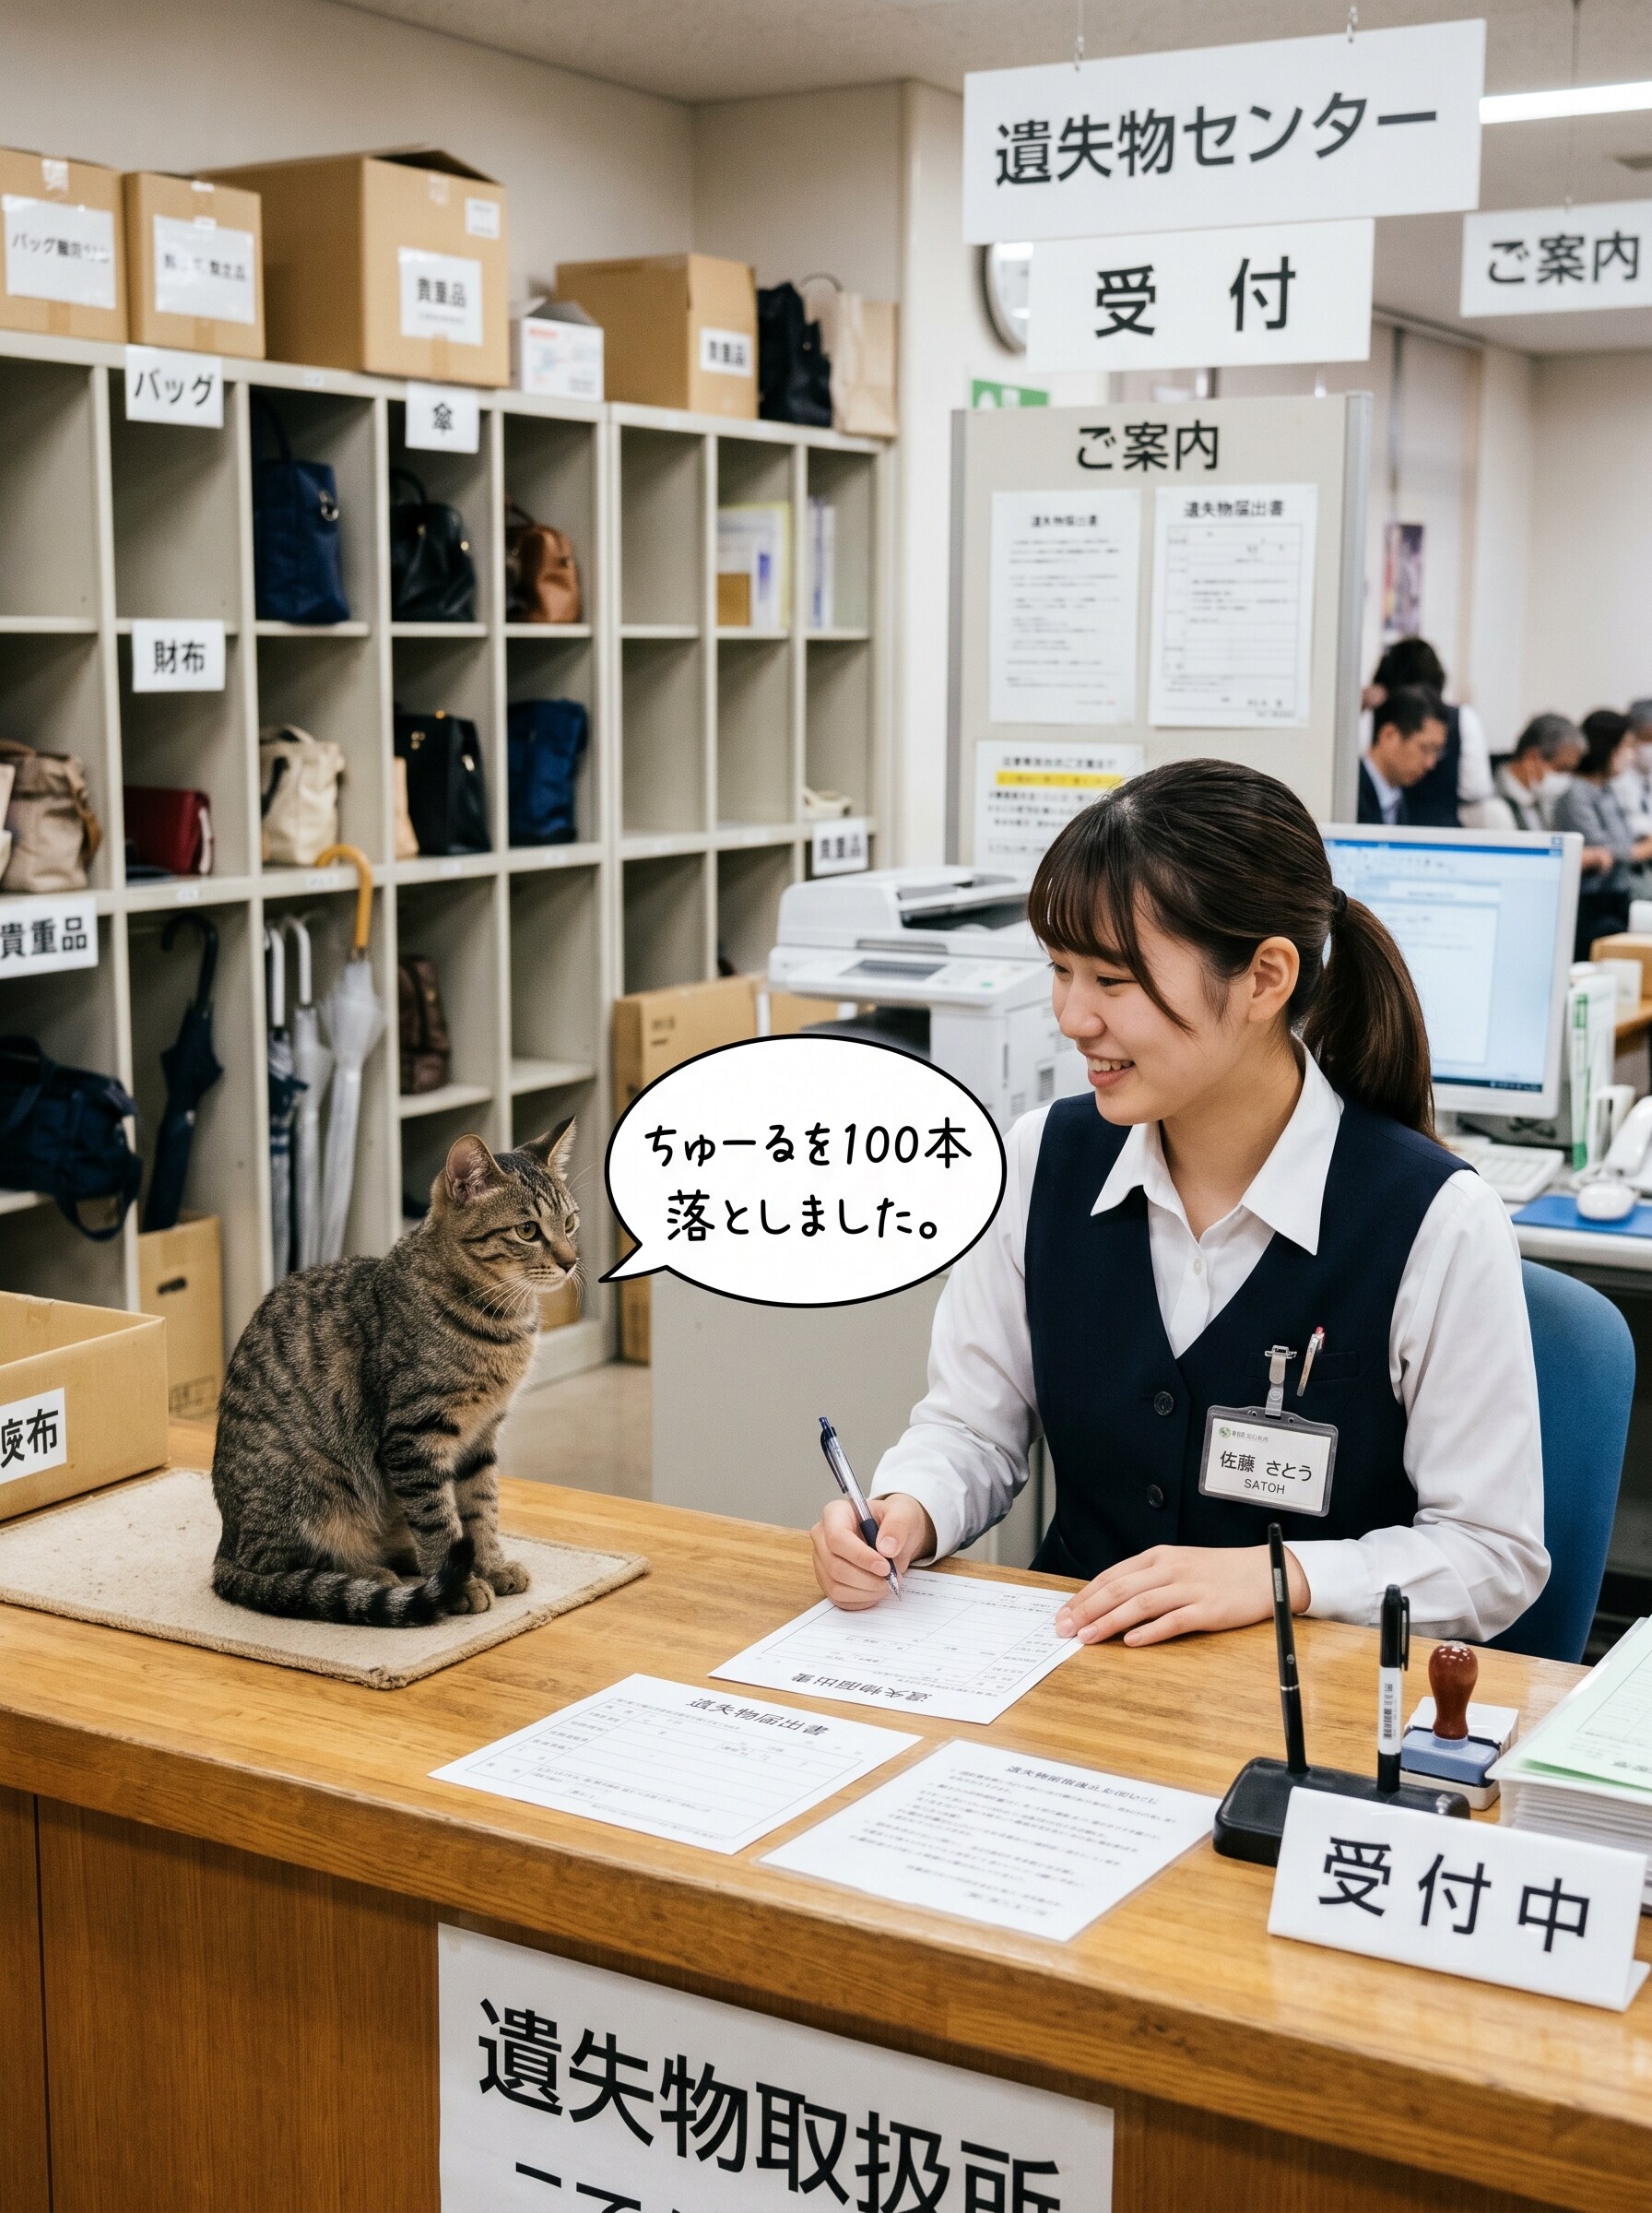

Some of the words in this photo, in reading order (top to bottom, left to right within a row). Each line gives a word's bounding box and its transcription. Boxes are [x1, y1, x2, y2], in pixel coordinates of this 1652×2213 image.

[996, 92, 1437, 186] 遺失物センター
[1487, 230, 1640, 286] ご案内
[1094, 255, 1296, 338] 受付
[134, 369, 214, 407] バッグ
[431, 402, 454, 434] 傘
[1077, 419, 1219, 472] ご案内
[154, 640, 206, 674] 財布
[0, 917, 88, 959] 貴重品
[1220, 1450, 1256, 1473] 佐藤
[1266, 1460, 1313, 1482] さとう
[1244, 1478, 1286, 1495] SATOH
[1317, 1836, 1590, 1953] 受付中
[478, 1998, 1062, 2213] 遺失物取扱所
